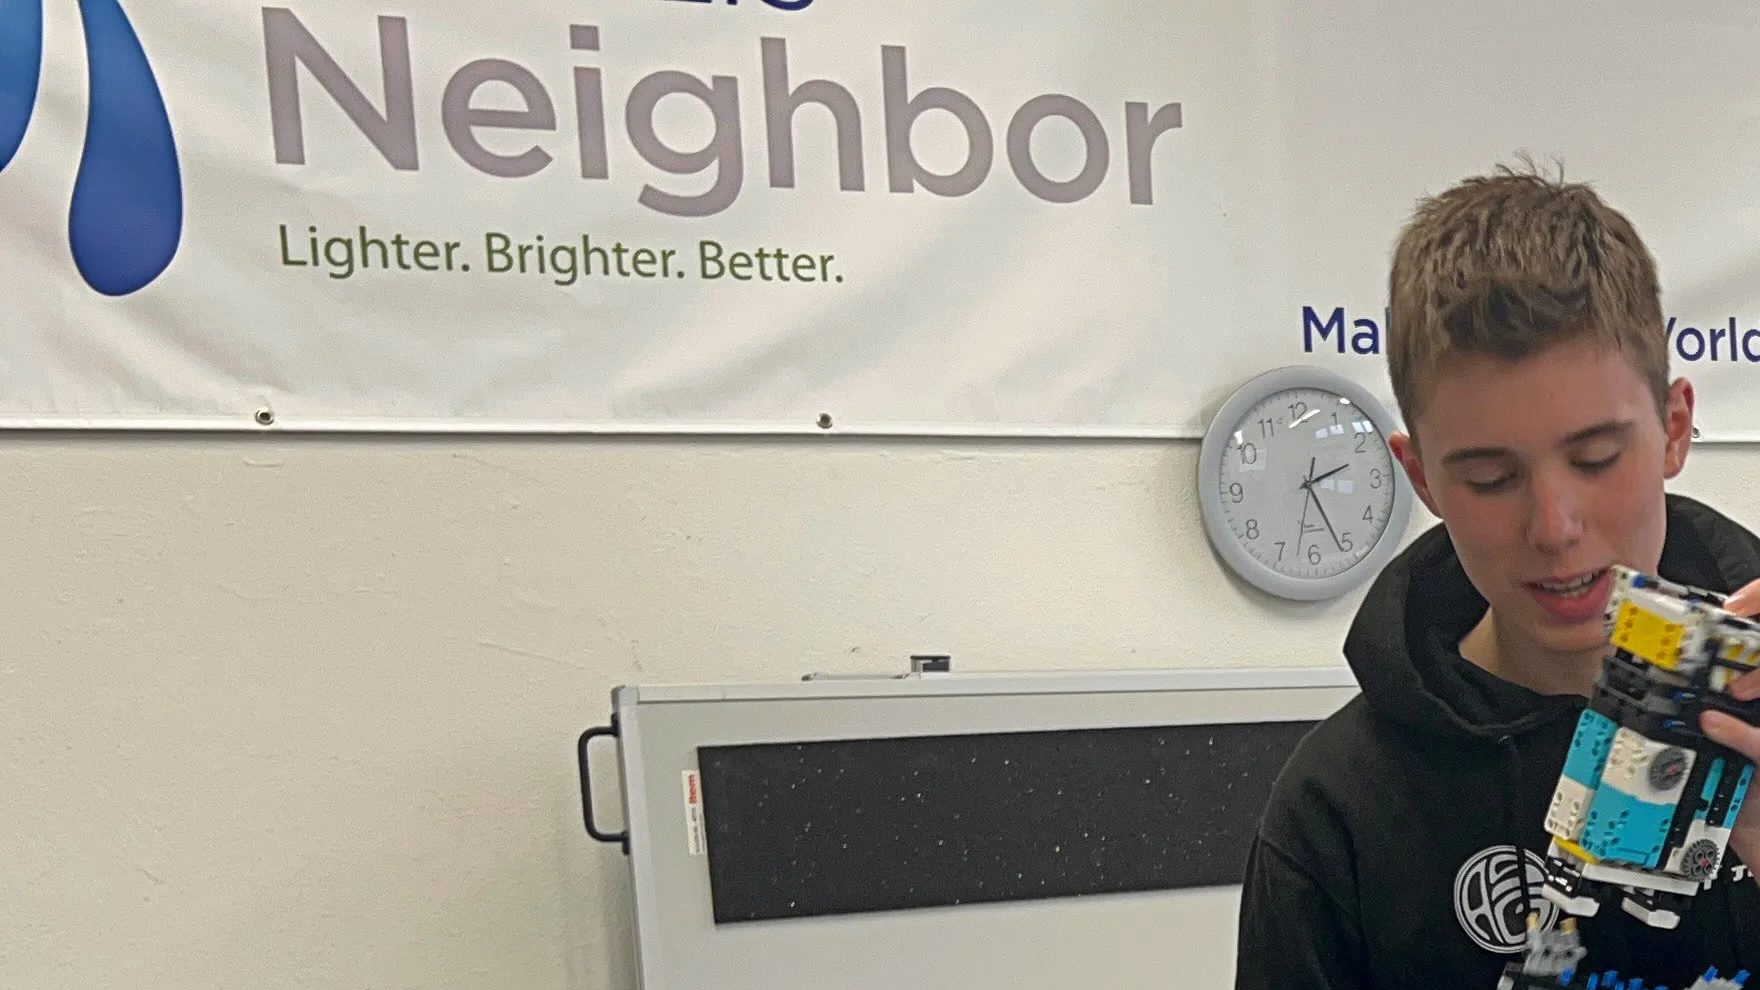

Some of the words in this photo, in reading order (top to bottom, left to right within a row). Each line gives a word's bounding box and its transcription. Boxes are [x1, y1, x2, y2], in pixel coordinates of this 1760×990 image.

[261, 6, 1183, 218] Neighbor
[278, 225, 470, 280] Lighter.
[484, 232, 685, 286] Brighter.
[699, 240, 844, 284] Better.
[1302, 306, 1390, 356] Ma
[1257, 417, 1275, 439] 11
[1238, 442, 1258, 465] 10
[1354, 432, 1367, 454] 2
[1369, 468, 1383, 490] 3
[1229, 482, 1245, 504] 9
[1362, 504, 1374, 524] 4
[1246, 519, 1260, 540] 8
[1274, 541, 1287, 562] 7
[1341, 532, 1354, 553] 5
[1307, 544, 1322, 566] 6
